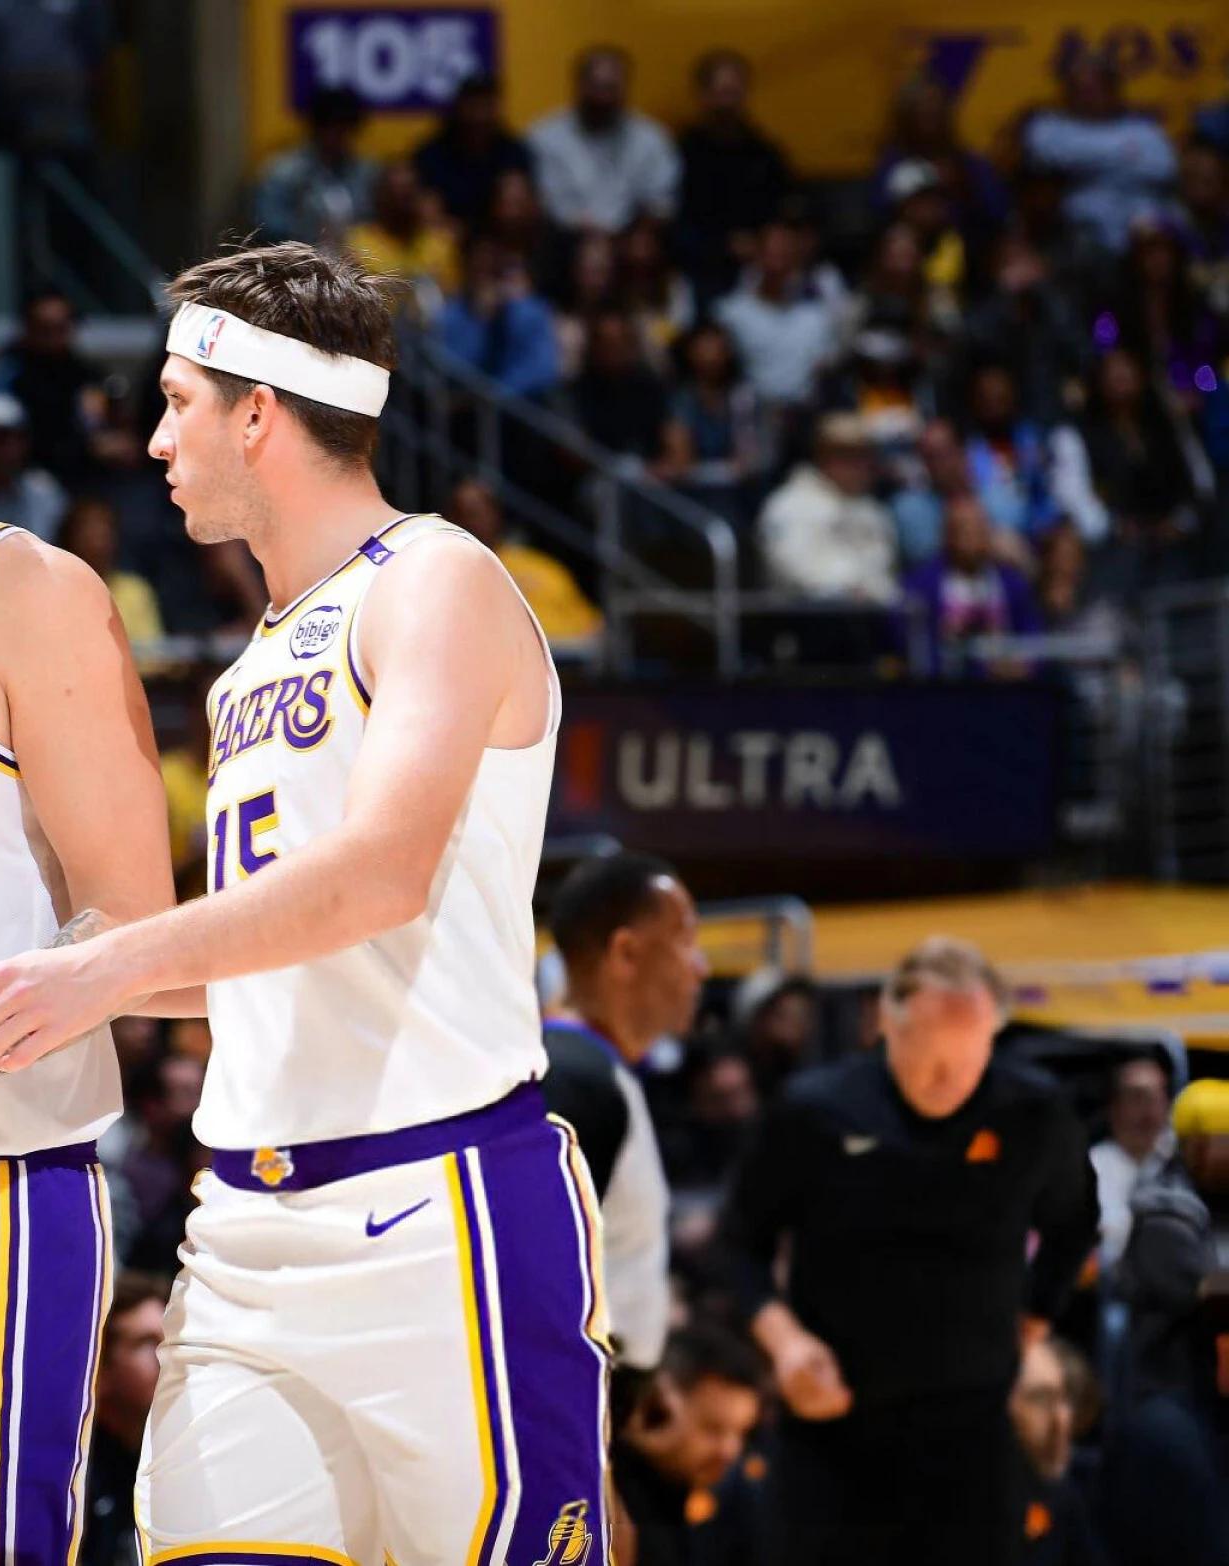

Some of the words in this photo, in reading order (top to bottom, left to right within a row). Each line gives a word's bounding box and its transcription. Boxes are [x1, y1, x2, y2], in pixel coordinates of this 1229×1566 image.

[305, 17, 475, 100] 105
[295, 619, 340, 642] bibigo
[616, 730, 904, 811] ULTRA
